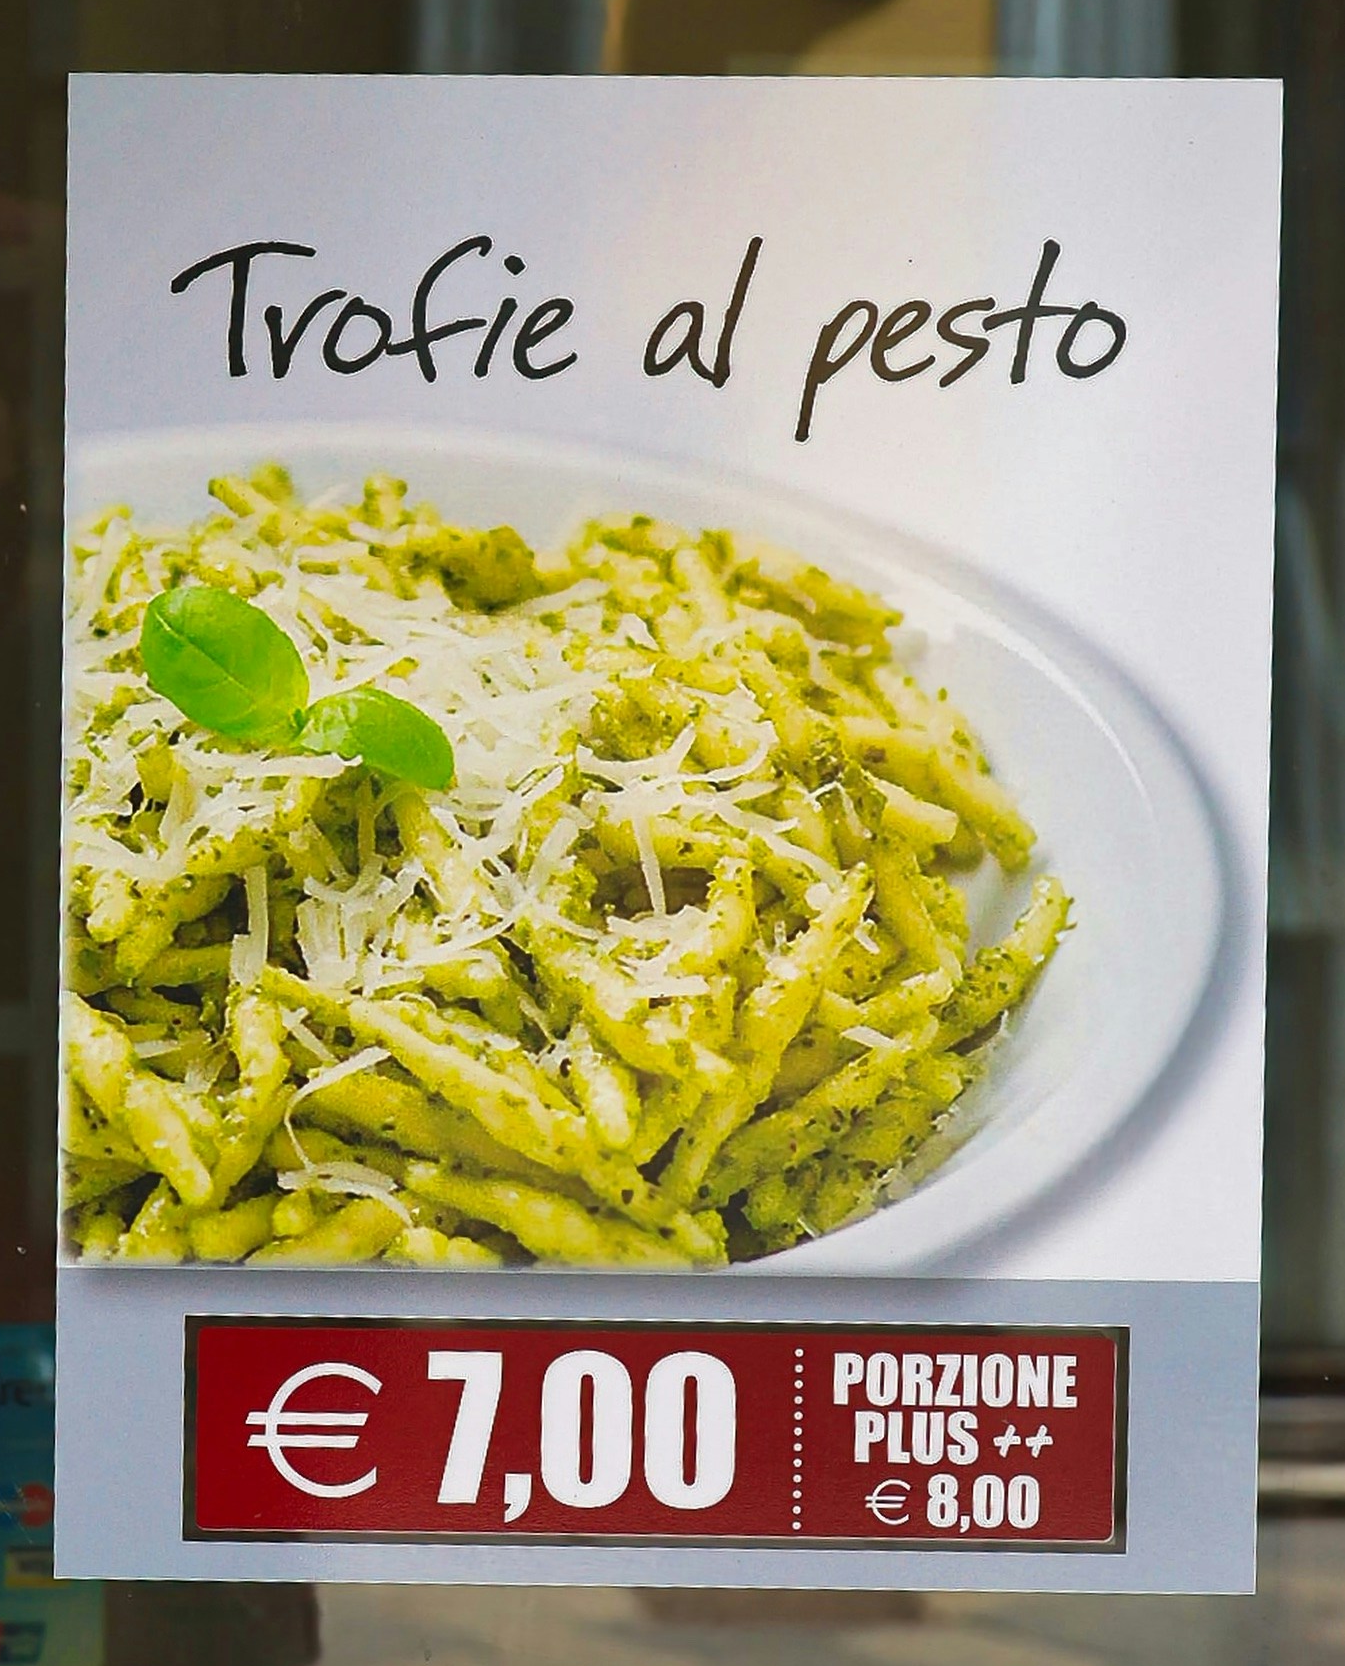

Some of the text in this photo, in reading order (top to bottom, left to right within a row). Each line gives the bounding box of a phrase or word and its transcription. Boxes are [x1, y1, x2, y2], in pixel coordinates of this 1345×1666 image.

[171, 236, 1126, 442] Trofie al pesto
[834, 1353, 1077, 1407] PORZIONE
[246, 1350, 736, 1522] € 7,00
[855, 1411, 1053, 1465] PLUS ++
[865, 1474, 1039, 1533] € 8,00
